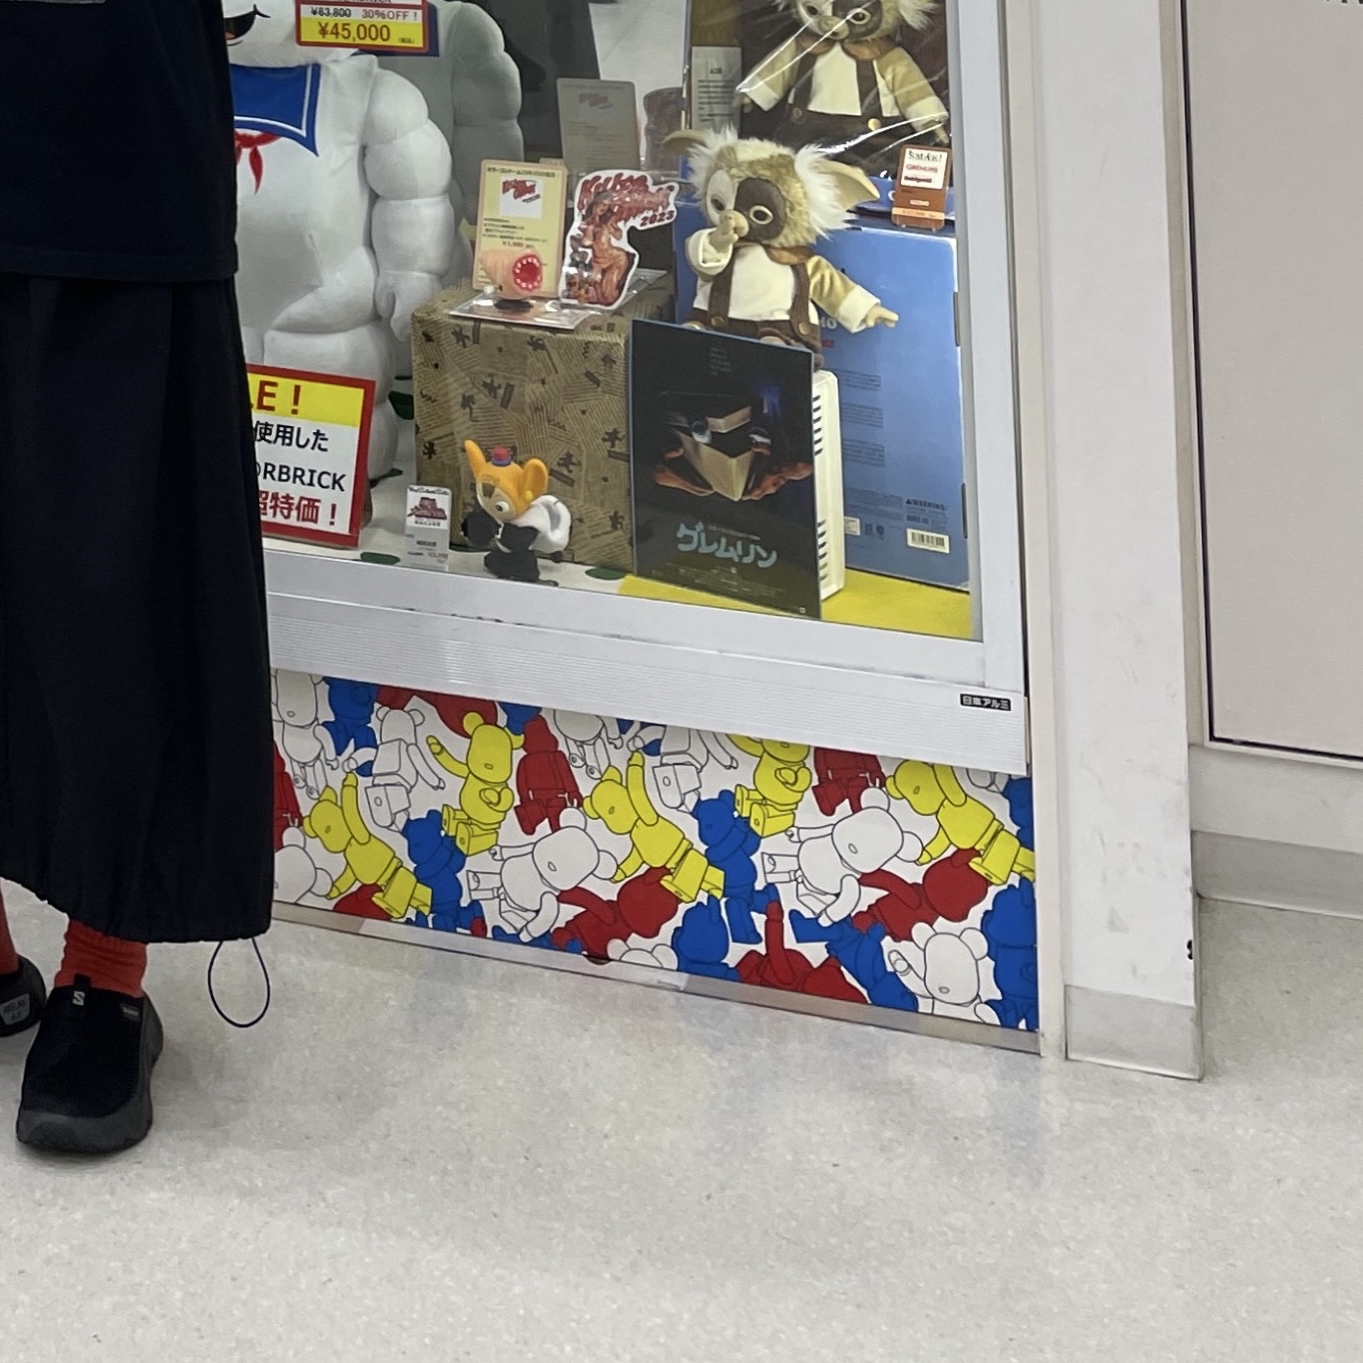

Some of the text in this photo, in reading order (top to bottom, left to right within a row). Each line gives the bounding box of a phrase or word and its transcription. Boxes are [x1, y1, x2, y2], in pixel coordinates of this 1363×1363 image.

[361, 10, 411, 21] 30%OFF
[318, 22, 392, 42] ¥45,000
[640, 209, 677, 227] 2023
[290, 385, 301, 415] !
[676, 522, 778, 568] グレムリン
